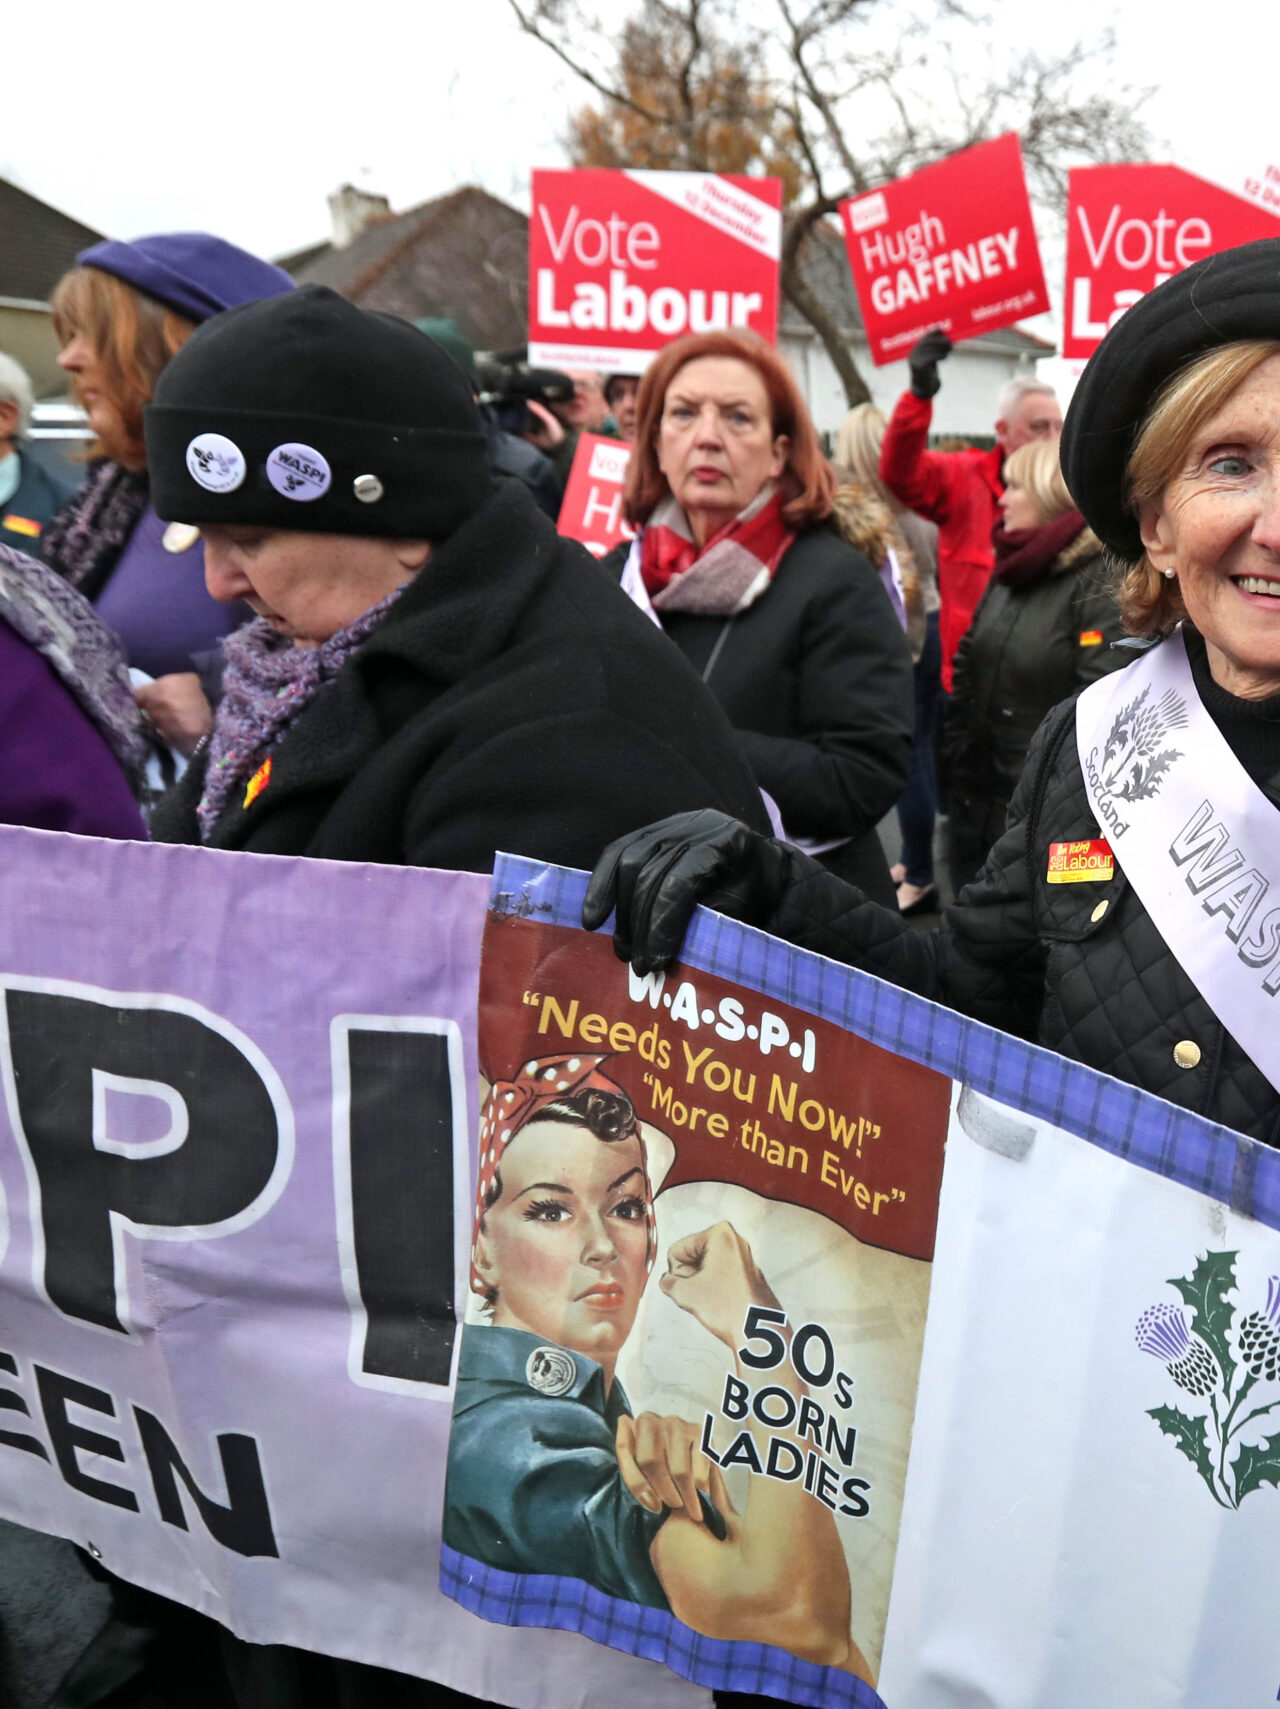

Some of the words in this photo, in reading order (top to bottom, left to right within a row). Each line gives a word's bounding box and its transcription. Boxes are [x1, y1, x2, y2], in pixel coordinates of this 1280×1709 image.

[1244, 177, 1261, 196] 12
[537, 203, 661, 270] Vote
[860, 209, 946, 275] Hugh
[1076, 204, 1213, 271] Vote
[537, 269, 763, 336] Labour
[870, 227, 1019, 316] GAFFNEY
[278, 450, 327, 483] WASPI
[1063, 854, 1114, 871] Labour
[681, 1040, 757, 1104] You
[740, 1118, 810, 1175] than
[721, 1372, 858, 1468] BORN
[700, 1412, 872, 1518] LADIES
